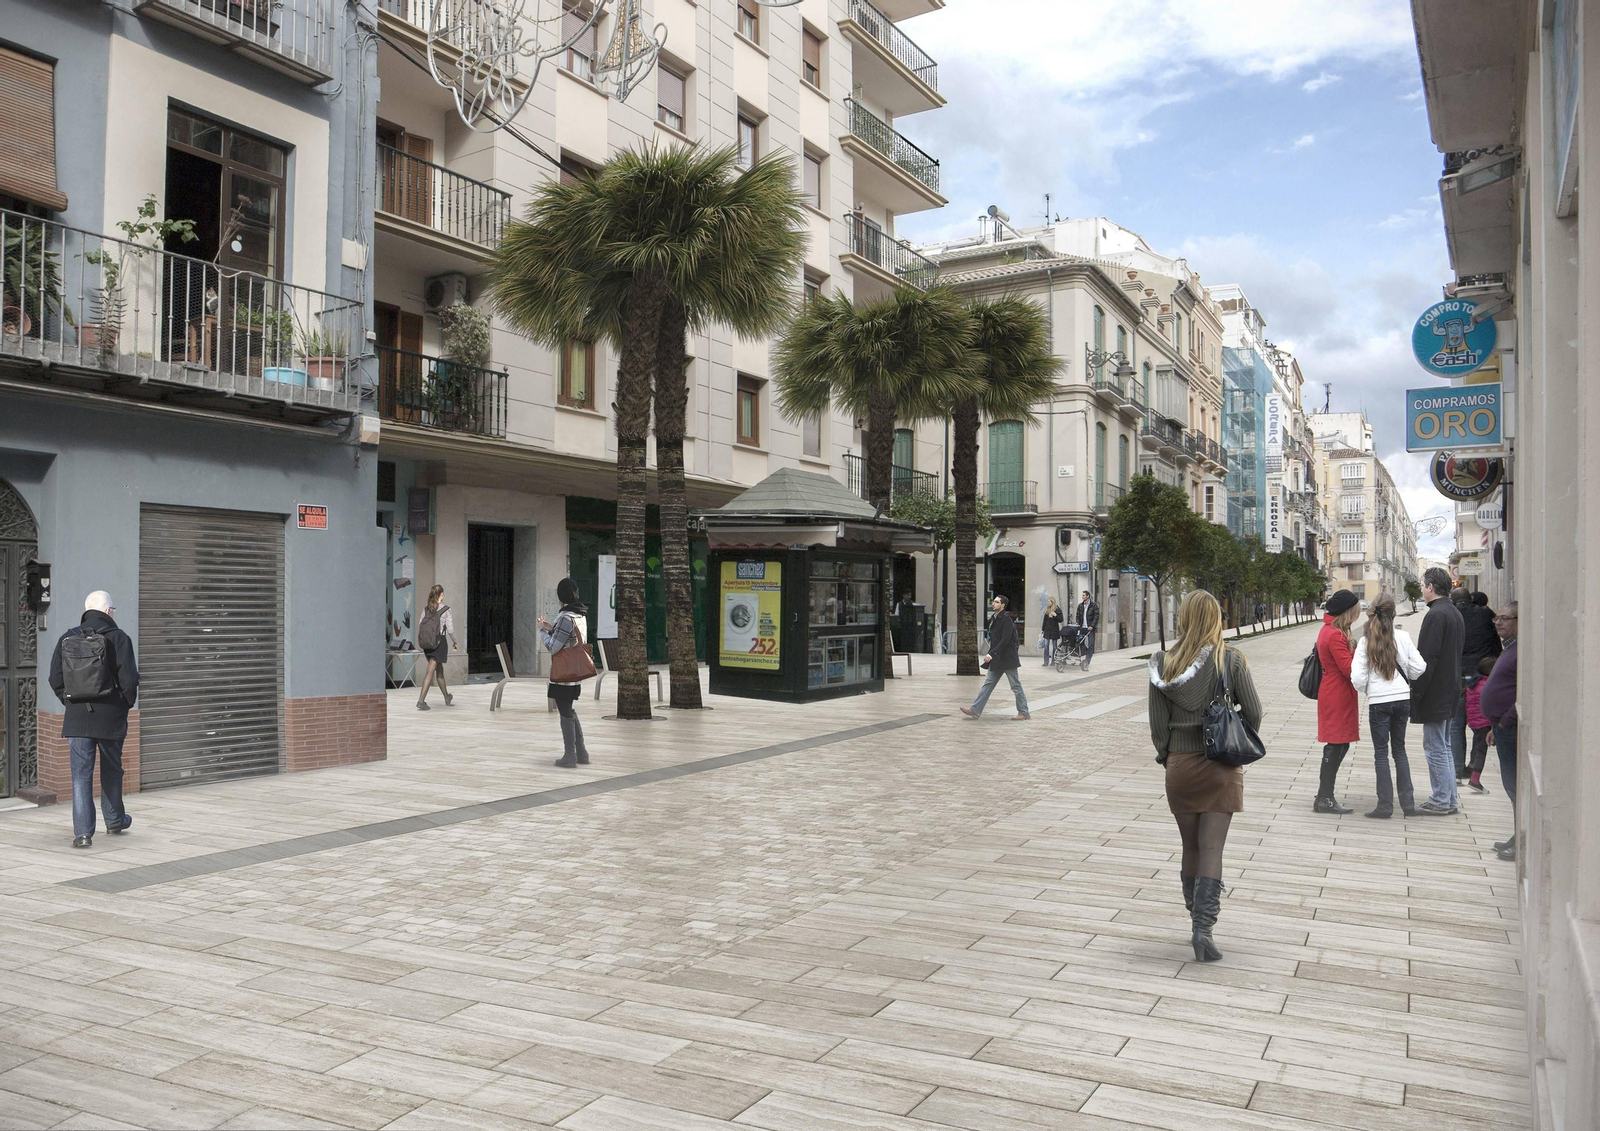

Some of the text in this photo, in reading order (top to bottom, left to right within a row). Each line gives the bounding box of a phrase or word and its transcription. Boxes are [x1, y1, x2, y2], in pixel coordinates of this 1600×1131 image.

[1420, 302, 1476, 327] COMPRO TO
[1414, 394, 1496, 410] COMPRAMOS
[1268, 398, 1280, 444] COREPA
[1414, 408, 1497, 440] ORO
[719, 655, 780, 665] centrohogarsanchez.es
